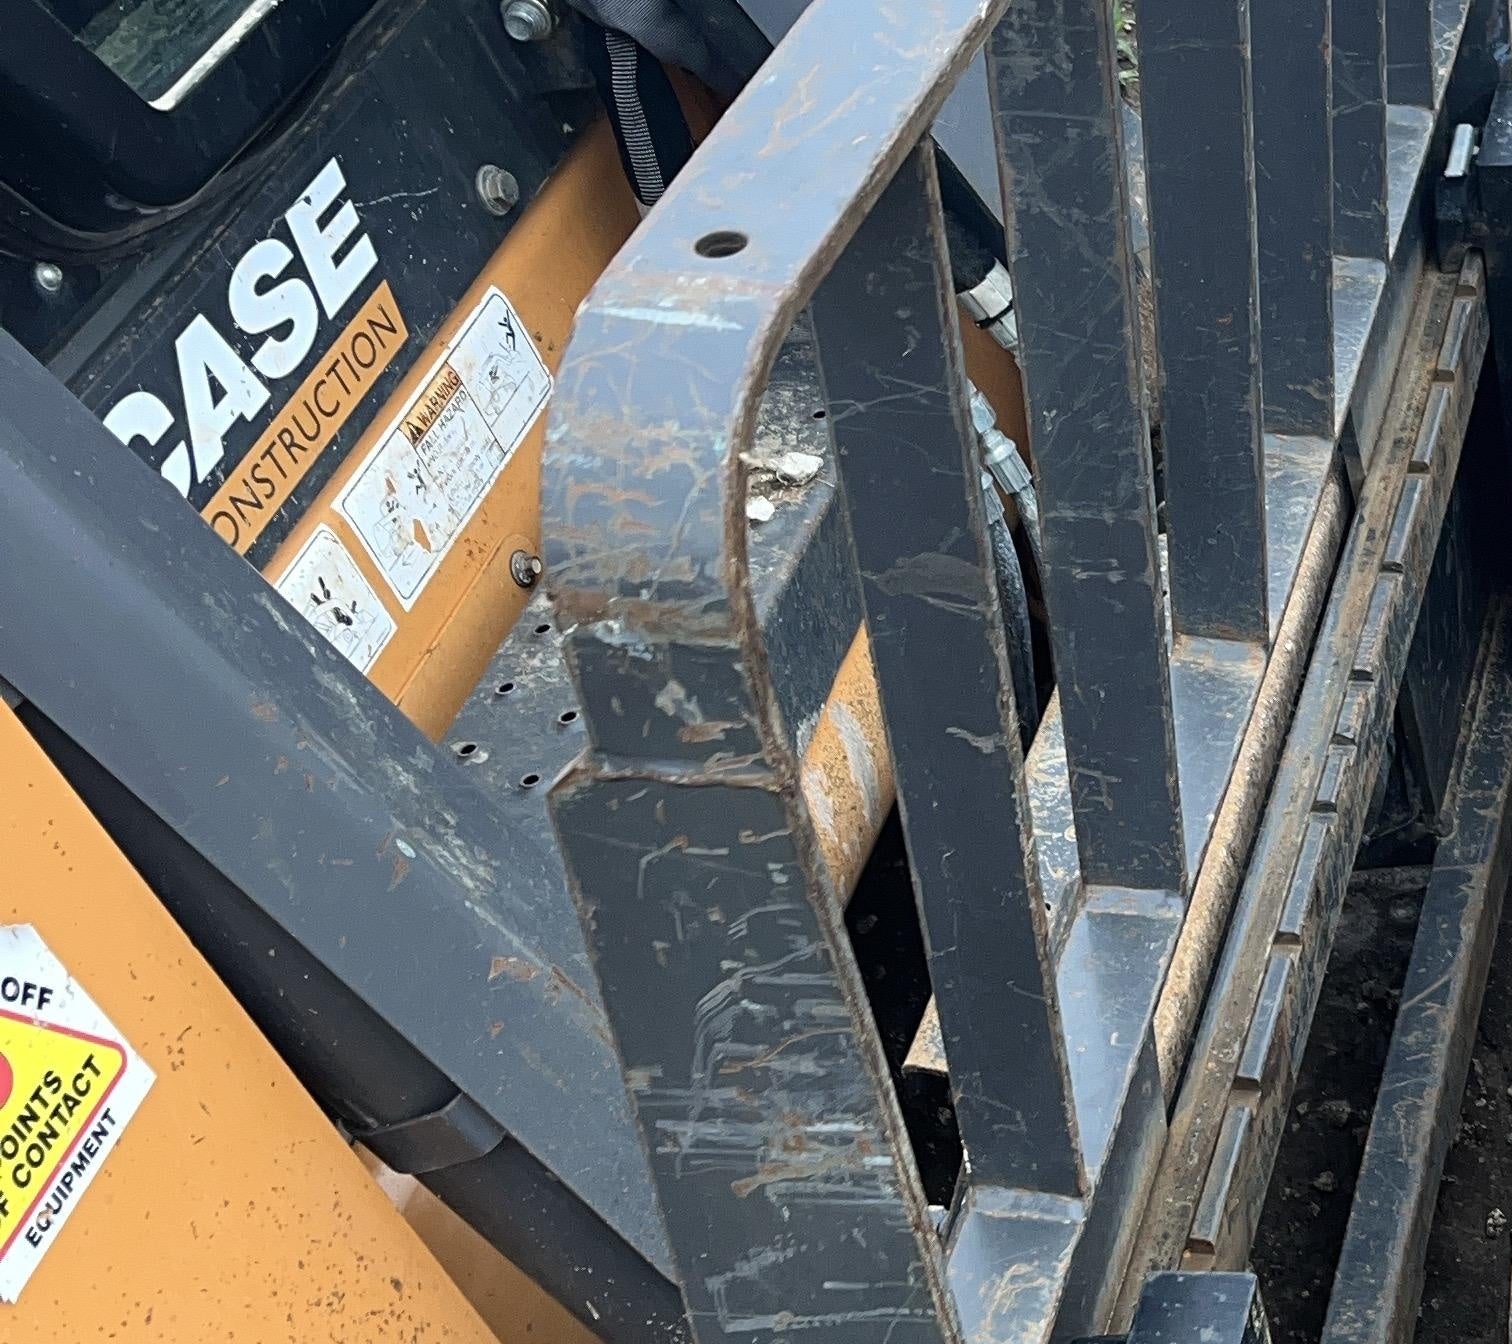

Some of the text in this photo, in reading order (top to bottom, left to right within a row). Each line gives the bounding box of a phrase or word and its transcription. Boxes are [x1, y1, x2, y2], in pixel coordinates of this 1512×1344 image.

[210, 303, 398, 546] ONSTRUCTION
[417, 371, 460, 427] WARNING
[420, 390, 467, 454] FALL HAZARD
[1, 976, 54, 1010] OFF
[0, 1070, 62, 1167] OINTS
[12, 1054, 101, 1189] CONTACT
[25, 1107, 117, 1248] EQUIPMENT
